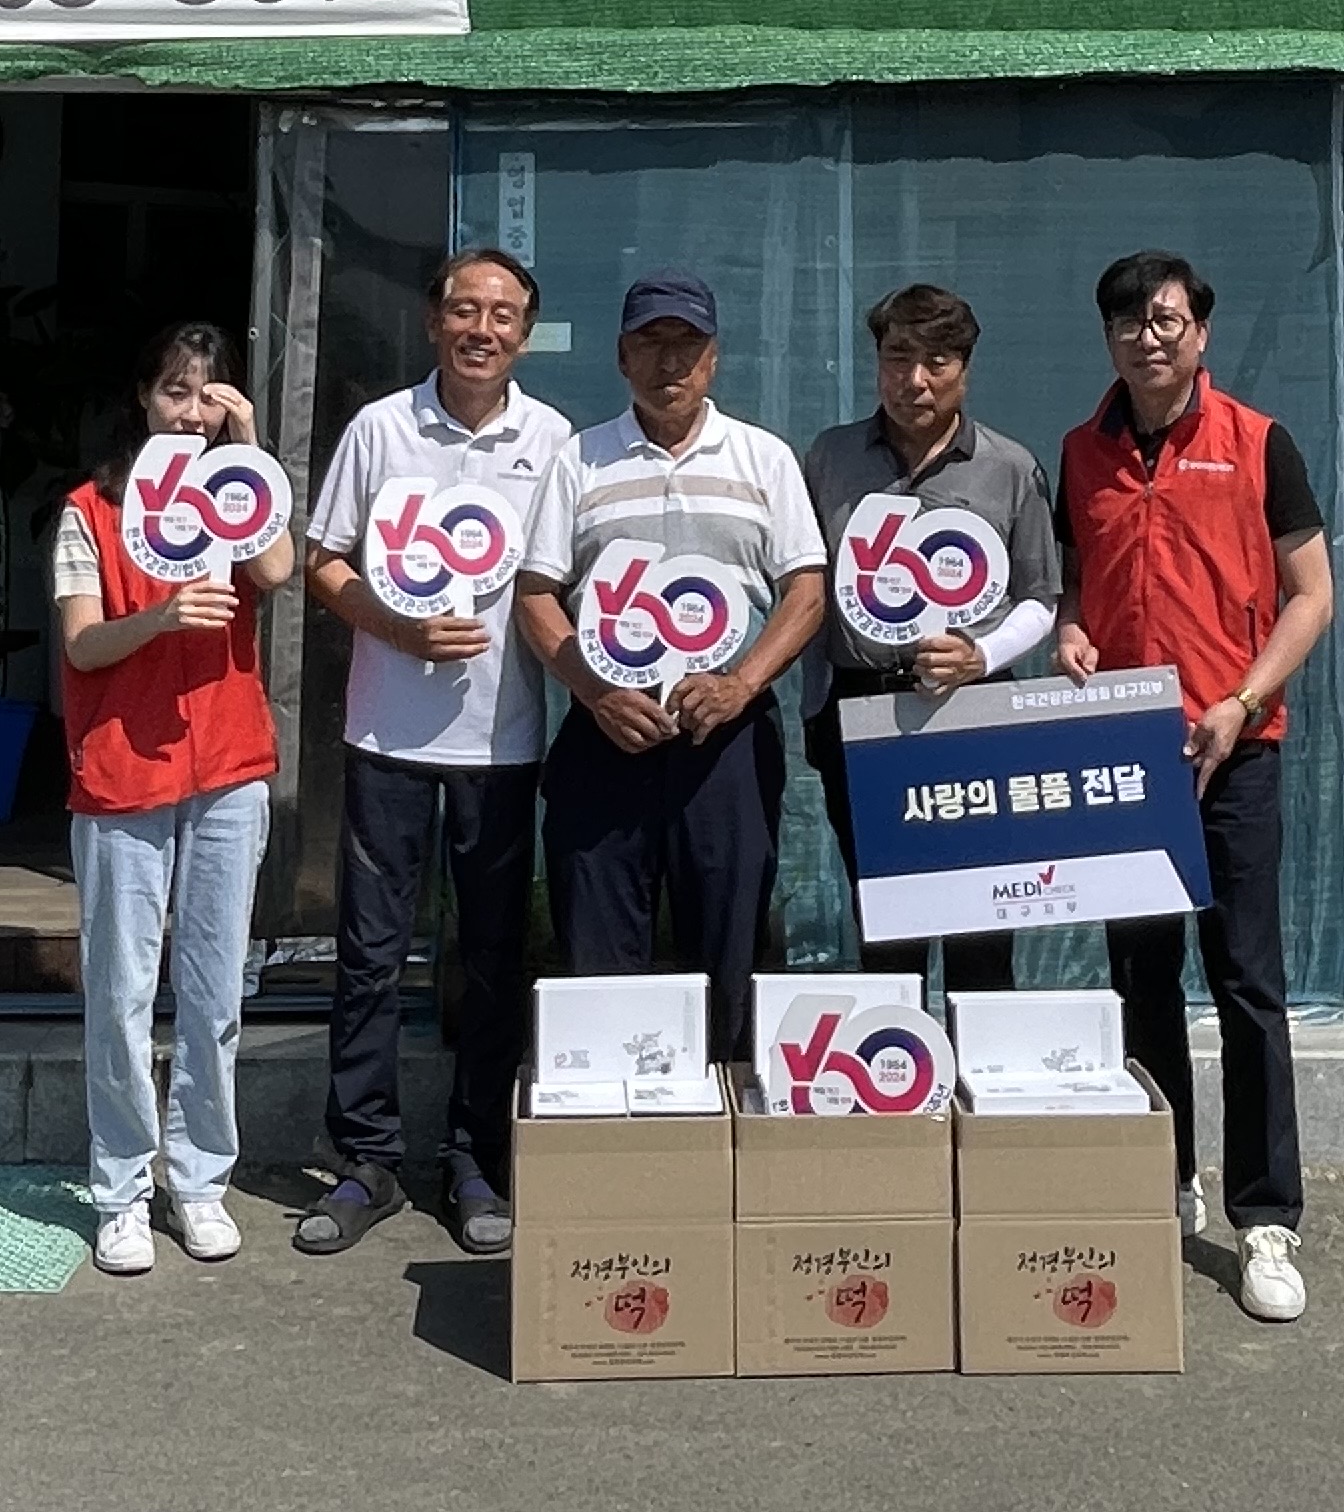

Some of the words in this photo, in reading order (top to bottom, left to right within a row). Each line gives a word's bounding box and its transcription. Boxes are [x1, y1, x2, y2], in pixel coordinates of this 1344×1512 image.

[903, 779, 998, 823] 사랑의
[1007, 771, 1072, 814] 물품
[1080, 762, 1147, 806] 전달
[614, 1286, 646, 1330] 떡
[836, 1280, 867, 1324] 떡
[1061, 1280, 1093, 1324] 떡
